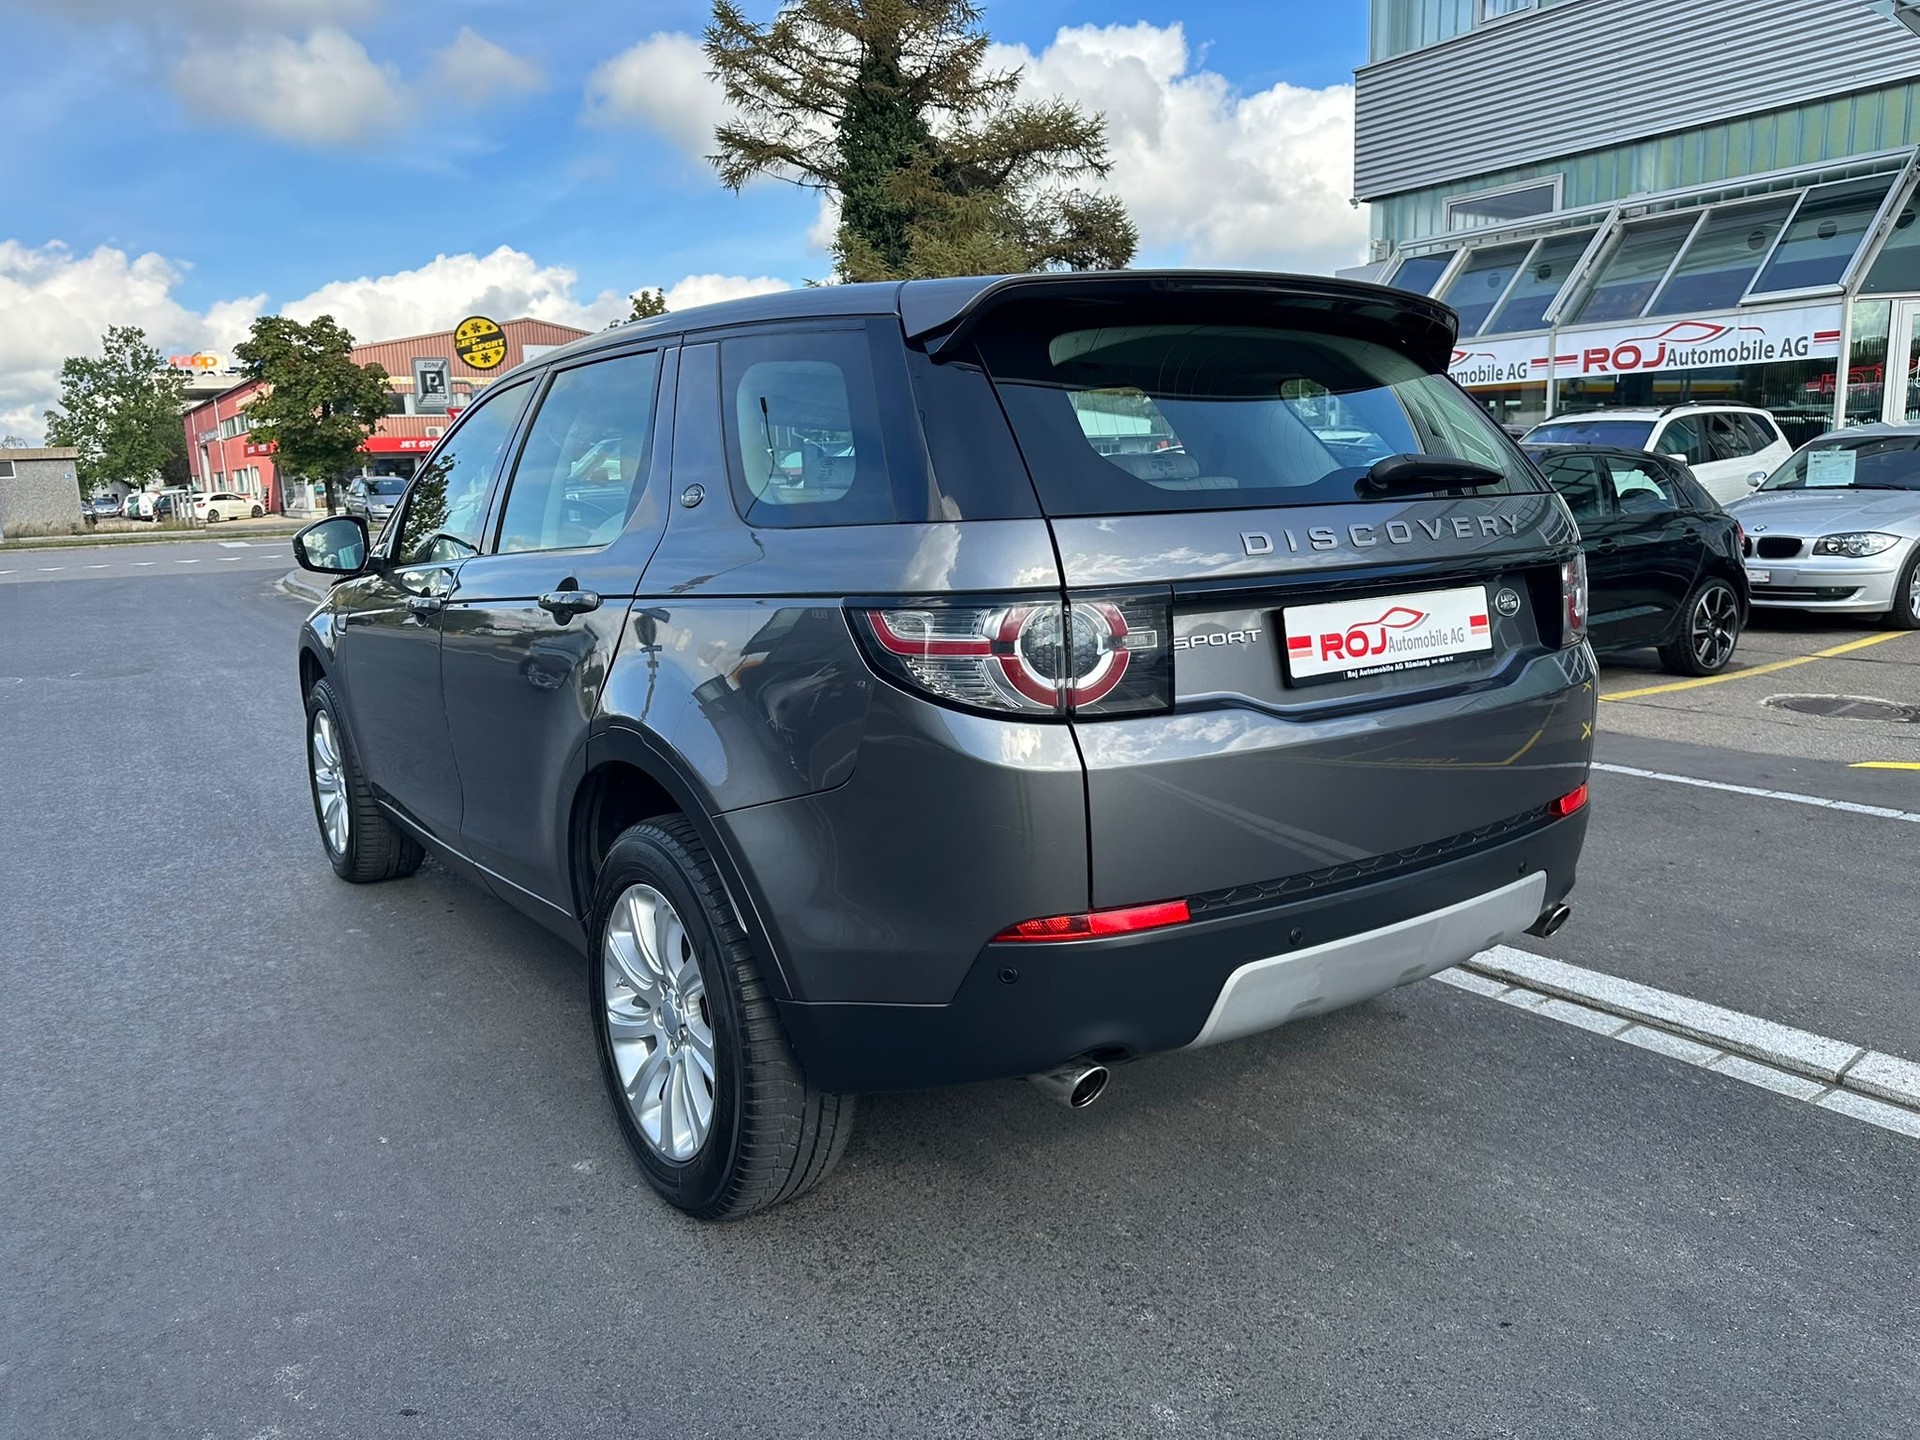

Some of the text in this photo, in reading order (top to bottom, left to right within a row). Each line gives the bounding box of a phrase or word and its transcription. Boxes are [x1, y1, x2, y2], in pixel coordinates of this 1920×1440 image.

[472, 338, 505, 352] SPORT
[1582, 335, 1809, 373] ROJ Automobile AG
[1506, 362, 1528, 380] AG
[400, 440, 418, 449] JET
[1240, 514, 1518, 556] DISCOVERY
[1173, 629, 1262, 650] SPORT
[1320, 627, 1466, 662] ROJ Automobile AG
[1347, 670, 1359, 679] Roj
[1359, 665, 1394, 677] Automobile
[1394, 662, 1405, 671] AG
